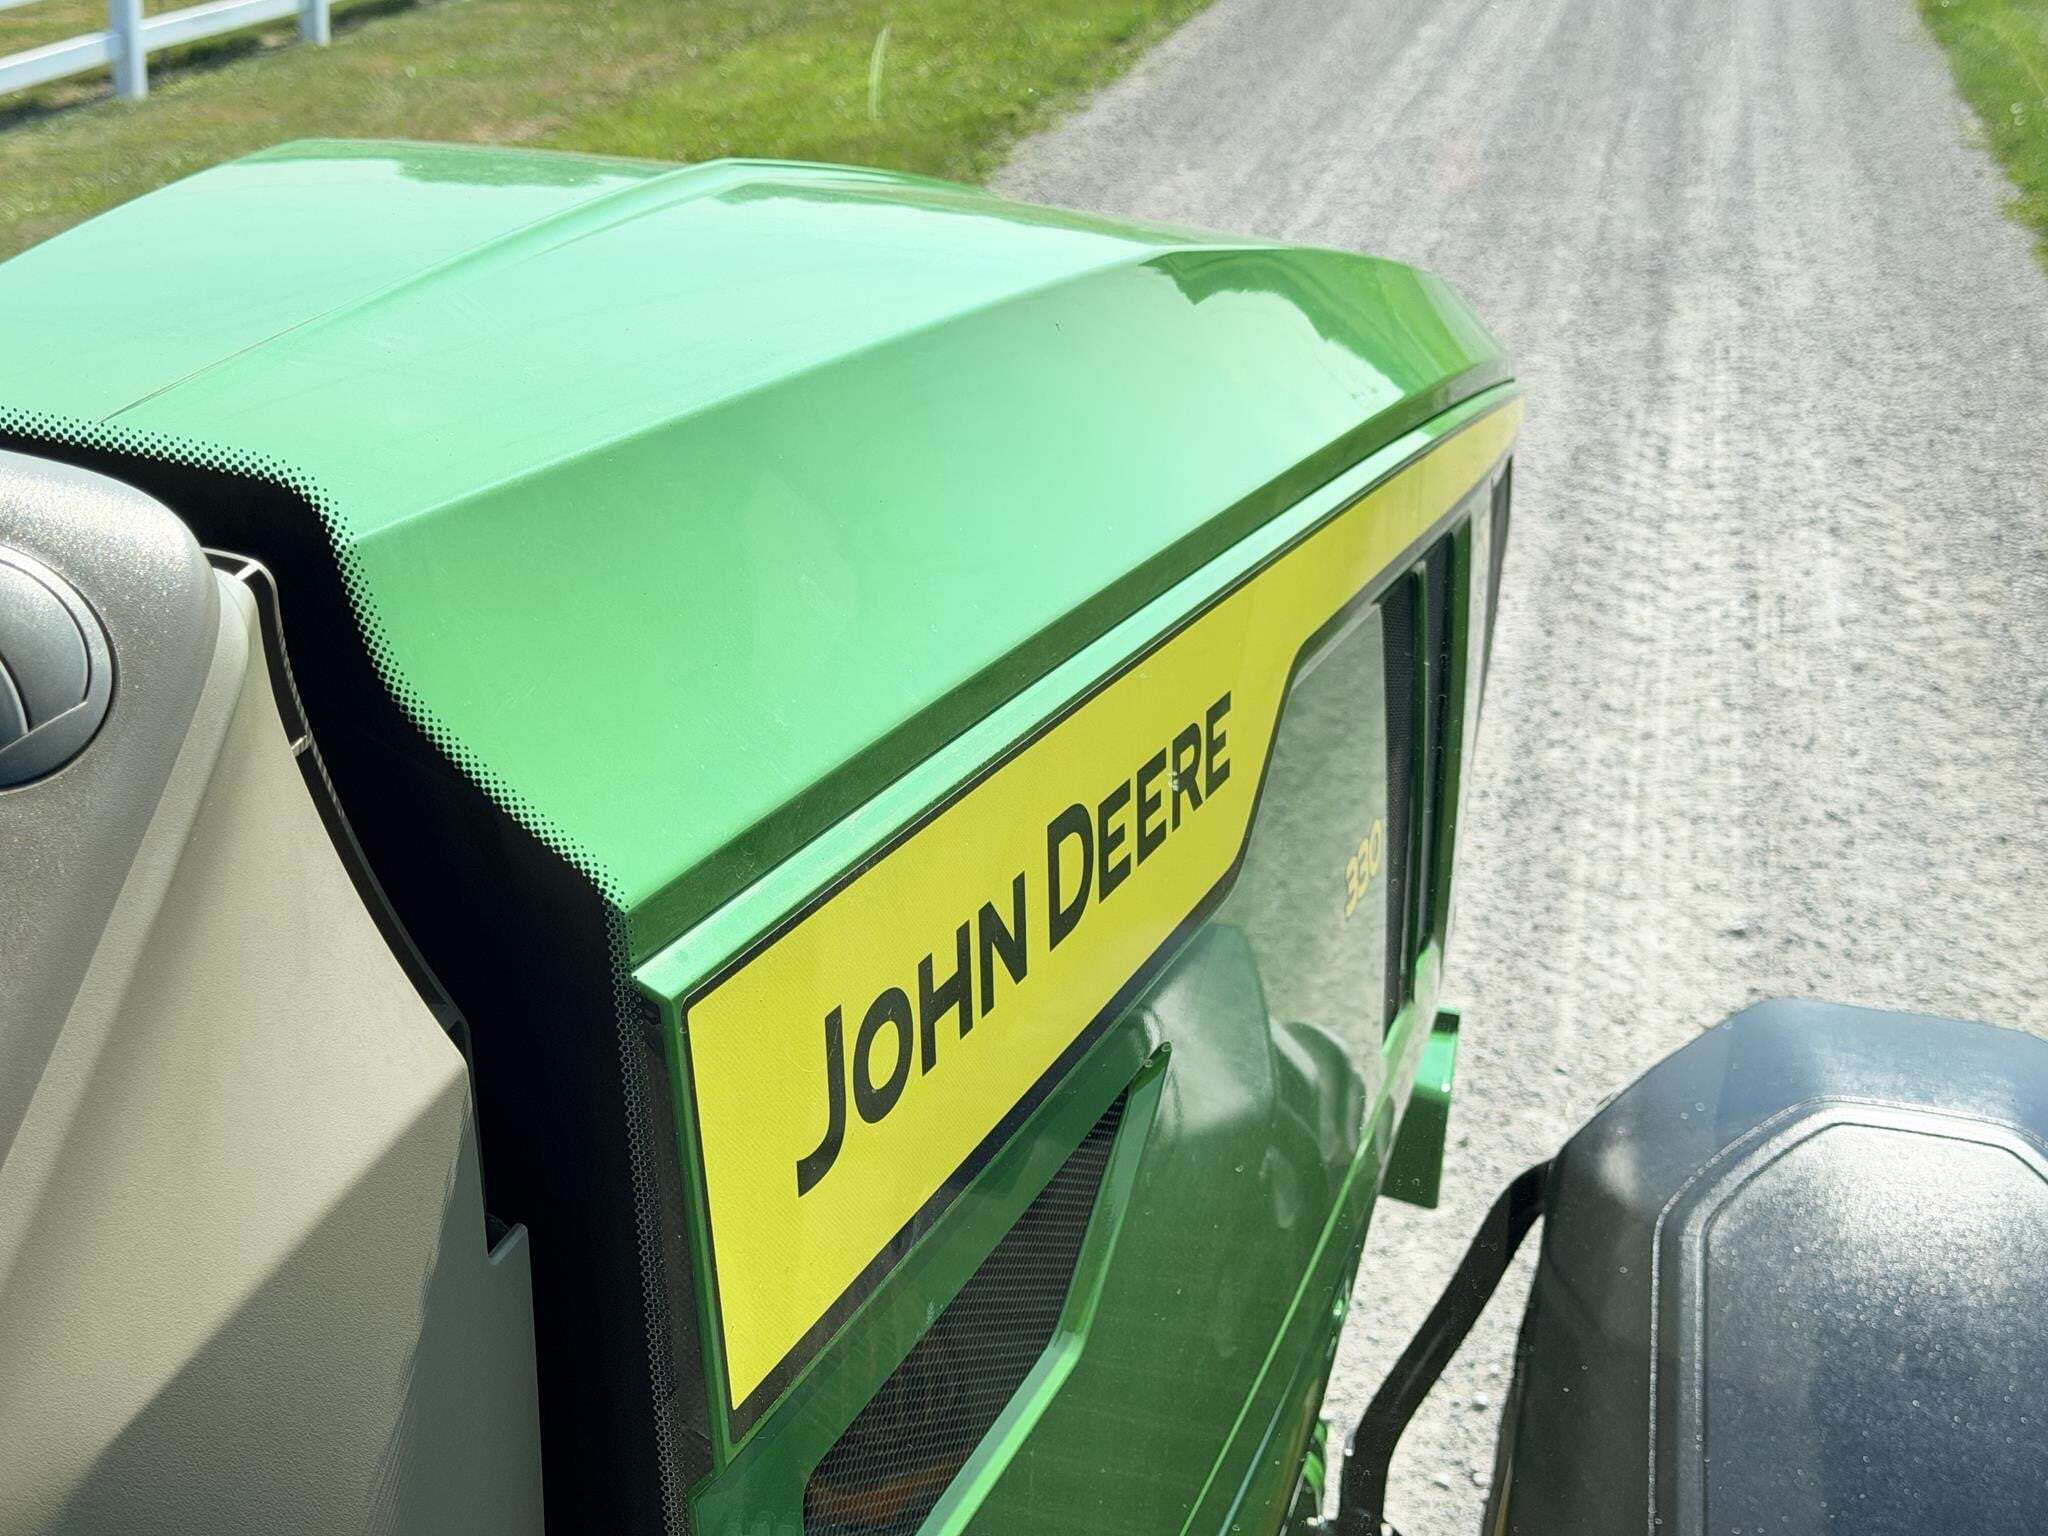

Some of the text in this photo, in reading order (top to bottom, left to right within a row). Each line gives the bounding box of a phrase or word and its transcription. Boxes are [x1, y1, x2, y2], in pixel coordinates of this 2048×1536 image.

[796, 690, 1232, 1198] JOHN DEERE
[1344, 818, 1382, 919] 330
